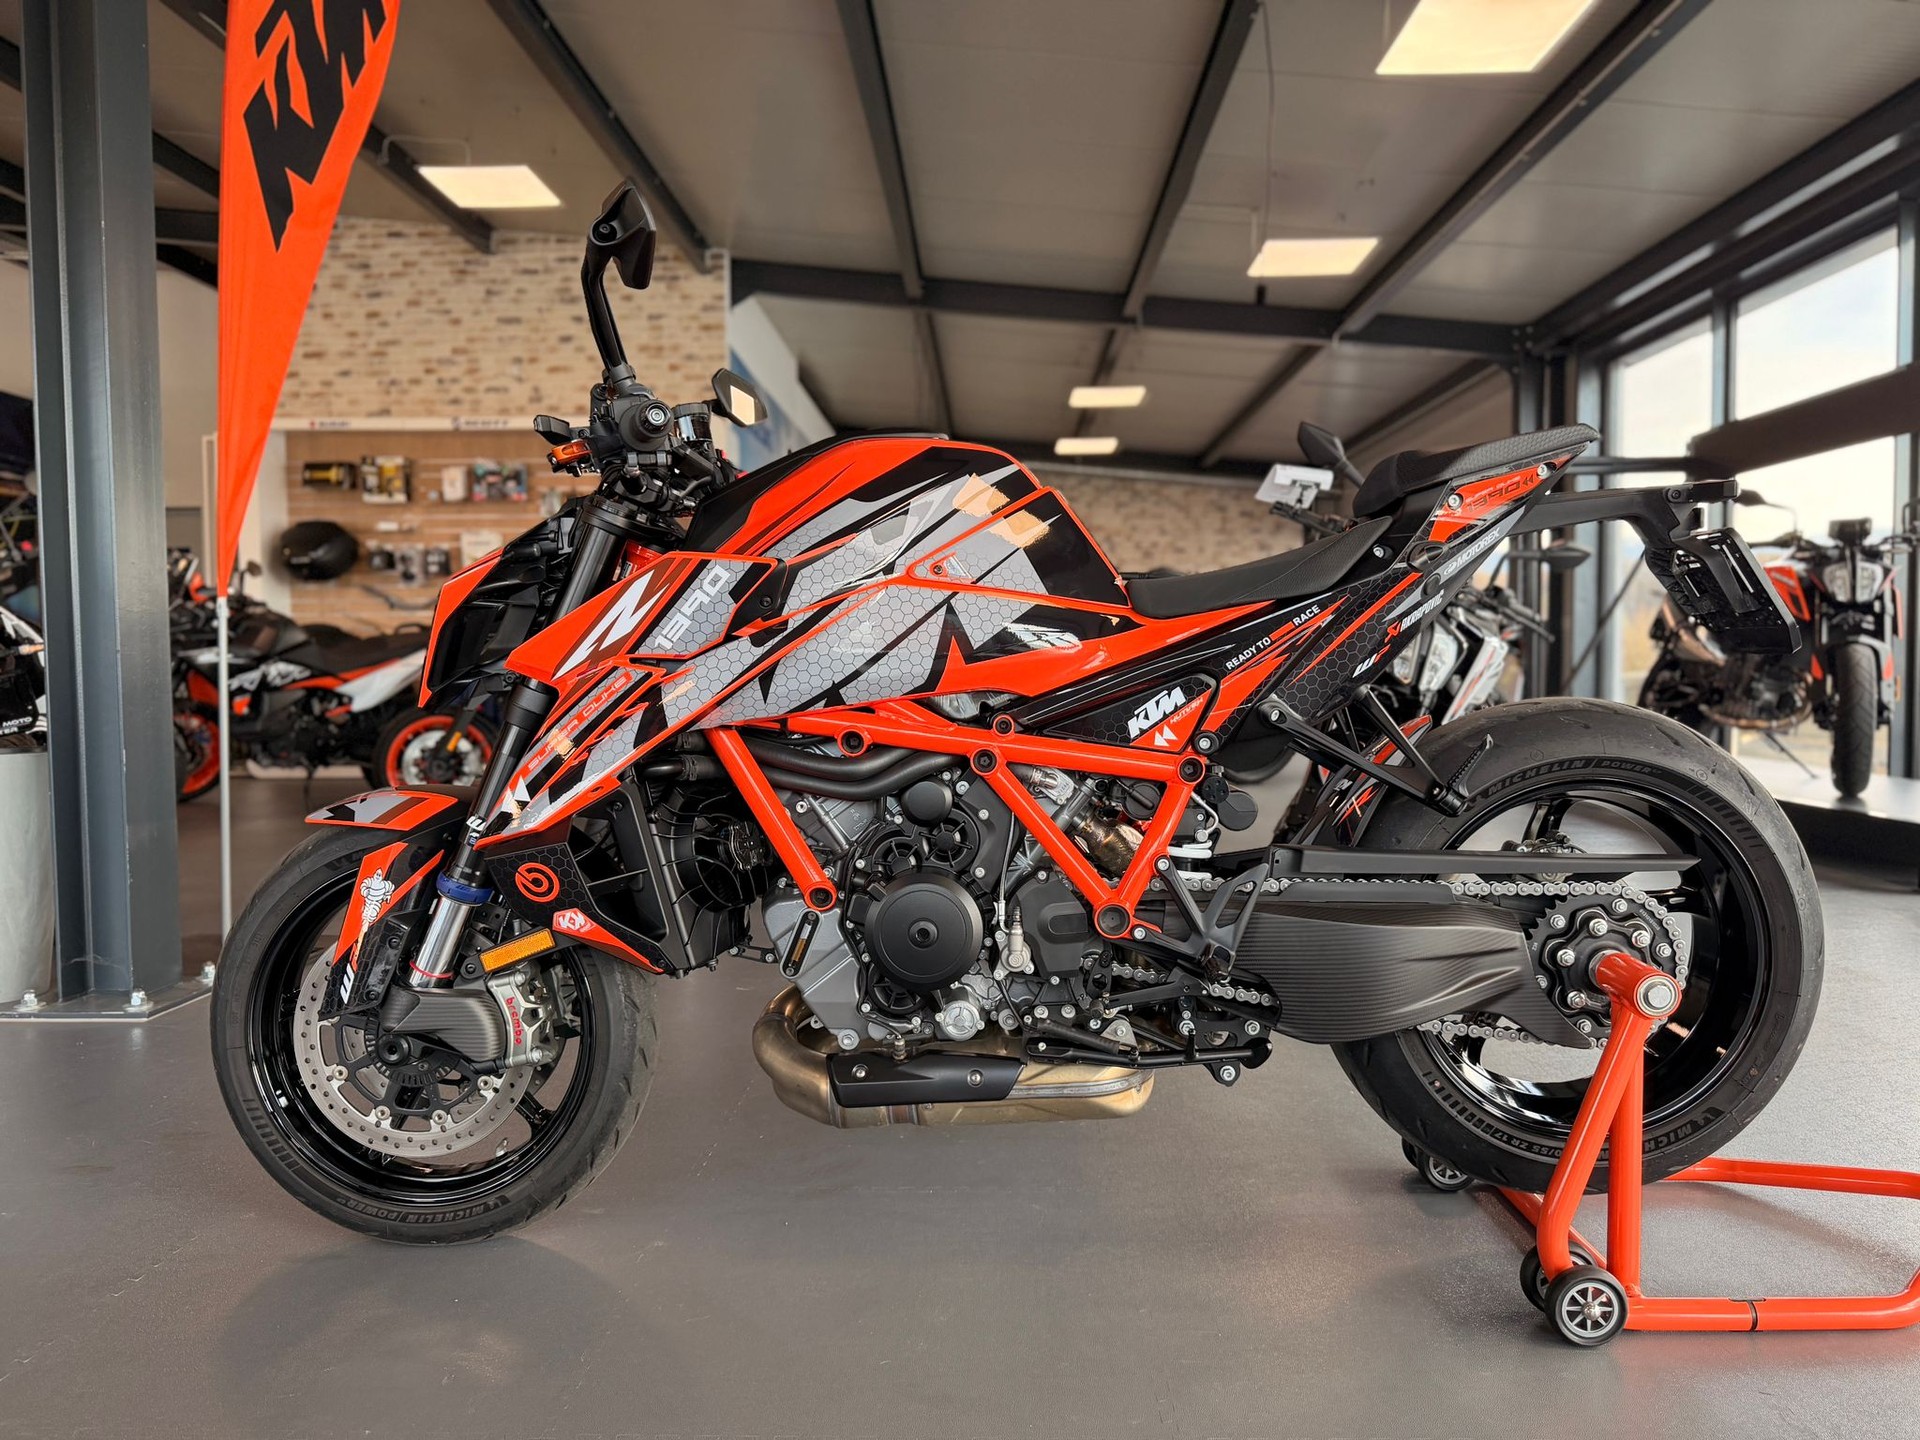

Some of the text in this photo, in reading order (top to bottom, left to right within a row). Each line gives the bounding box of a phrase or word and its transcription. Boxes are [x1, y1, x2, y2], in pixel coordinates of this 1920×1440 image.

[1455, 527, 1501, 567] MOTOREX
[655, 564, 731, 650] 1390
[1225, 605, 1321, 671] READY TO RACE
[527, 674, 629, 772] SUPER DUKE
[1127, 687, 1187, 740] KTM
[1487, 758, 1652, 796] MICHELIN POWER
[506, 996, 523, 1045] brembo
[346, 1198, 485, 1223] MICHELIN POWER
